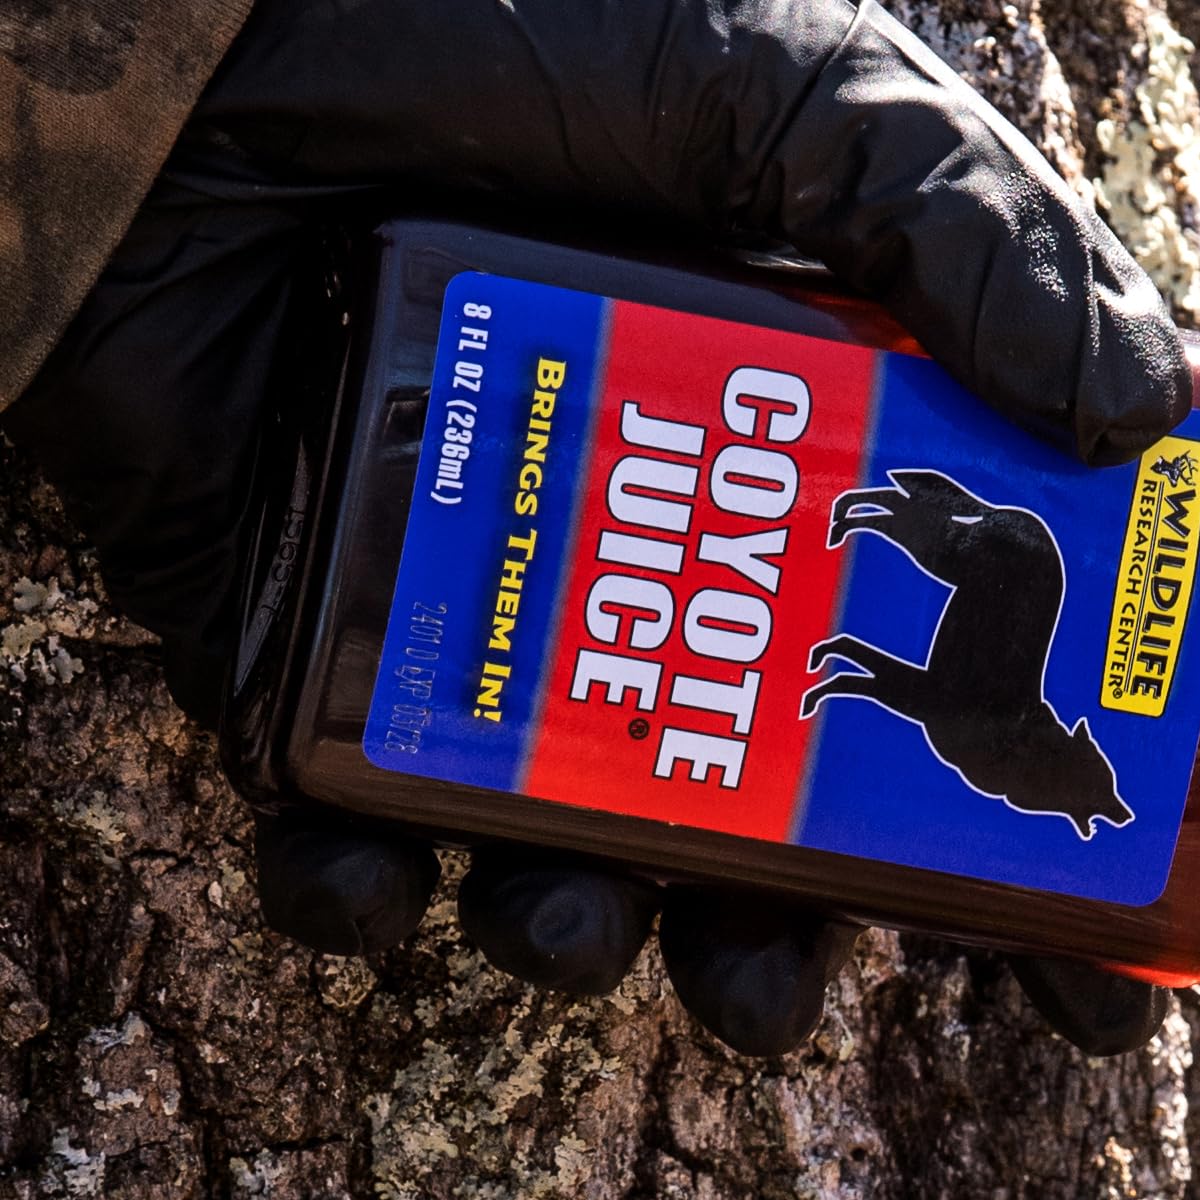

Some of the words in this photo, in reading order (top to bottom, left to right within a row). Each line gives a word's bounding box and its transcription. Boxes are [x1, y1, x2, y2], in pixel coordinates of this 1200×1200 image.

[458, 326, 488, 351] FL
[463, 302, 492, 320] 8
[453, 361, 484, 392] OZ
[430, 399, 478, 505] (236mL)
[514, 356, 567, 516] BRINGS
[487, 528, 538, 652] THEM
[653, 365, 811, 790] COYOTE
[1125, 479, 1158, 595] RESEARCH
[1129, 489, 1197, 700] WILDLIFE
[473, 662, 512, 722] IN!
